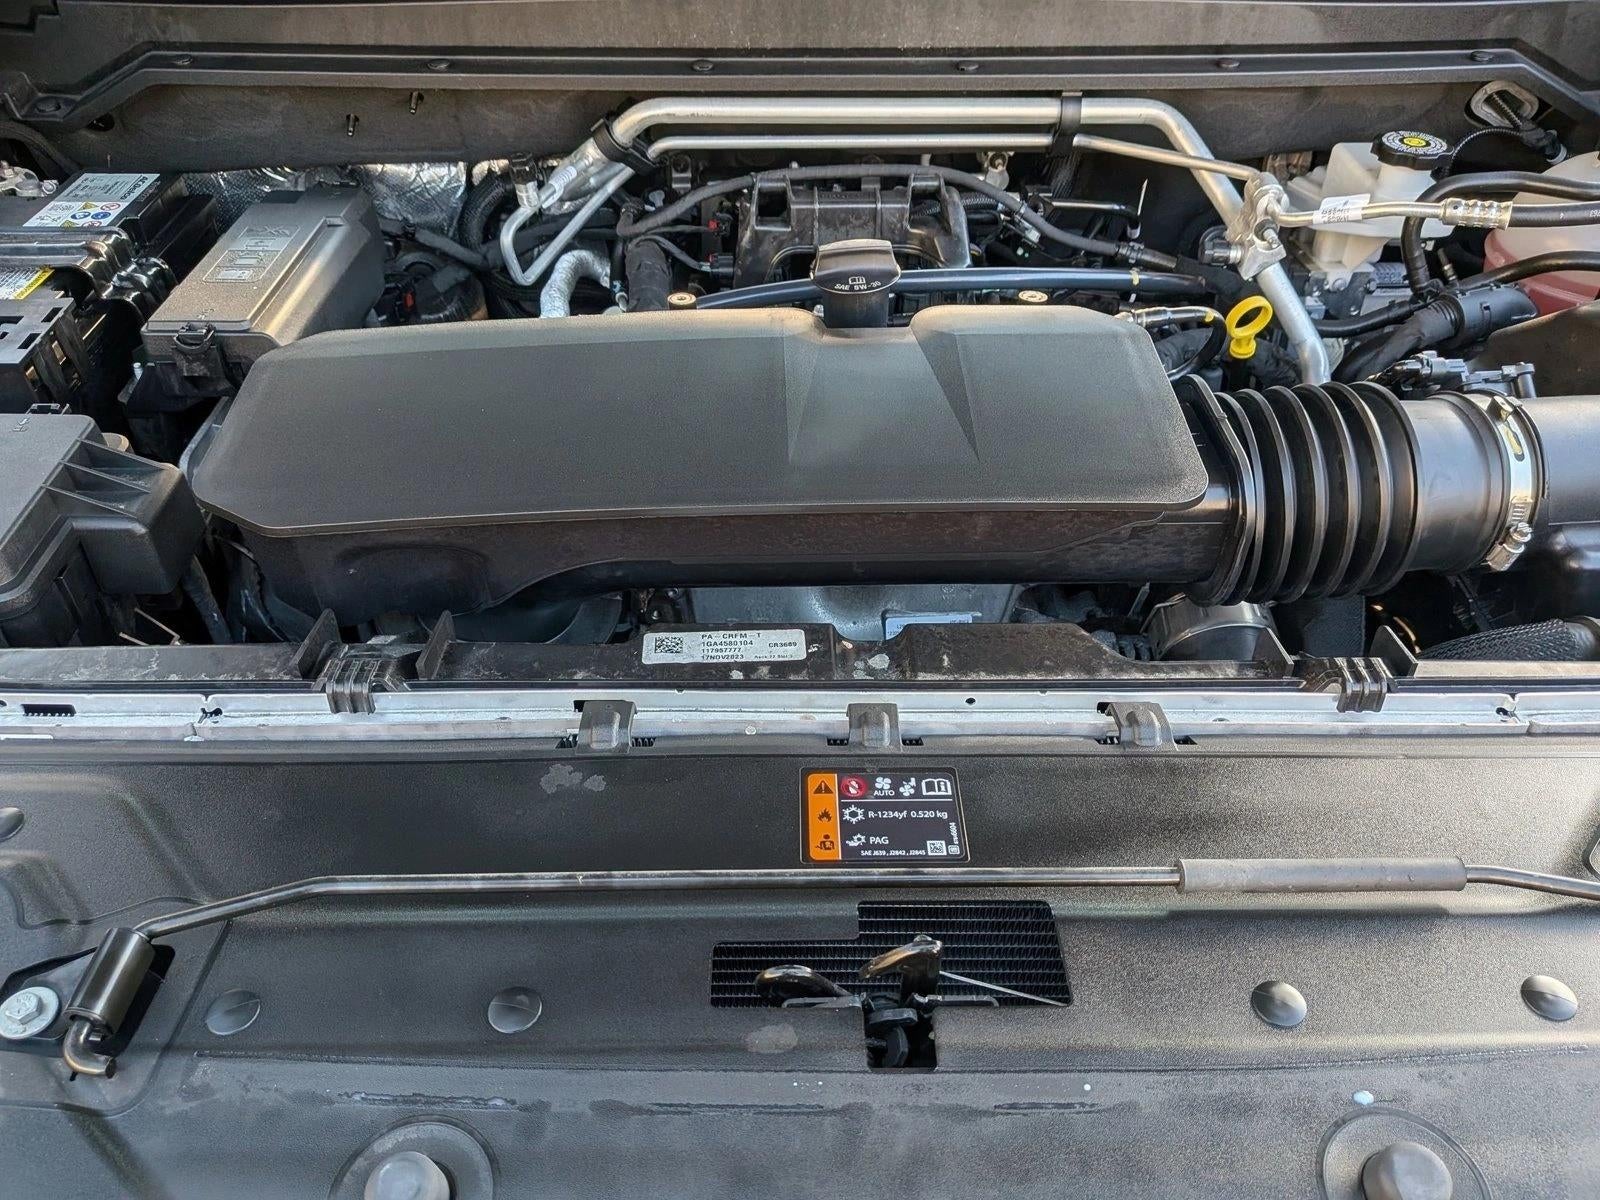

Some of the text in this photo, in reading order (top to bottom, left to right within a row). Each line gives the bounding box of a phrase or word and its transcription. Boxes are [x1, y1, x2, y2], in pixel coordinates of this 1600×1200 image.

[120, 176, 149, 200] ACDelco
[834, 283, 850, 291] SAE
[722, 632, 748, 640] CRFM
[868, 810, 949, 820] R-1234yf 0.520 kg
[869, 836, 890, 845] PAG
